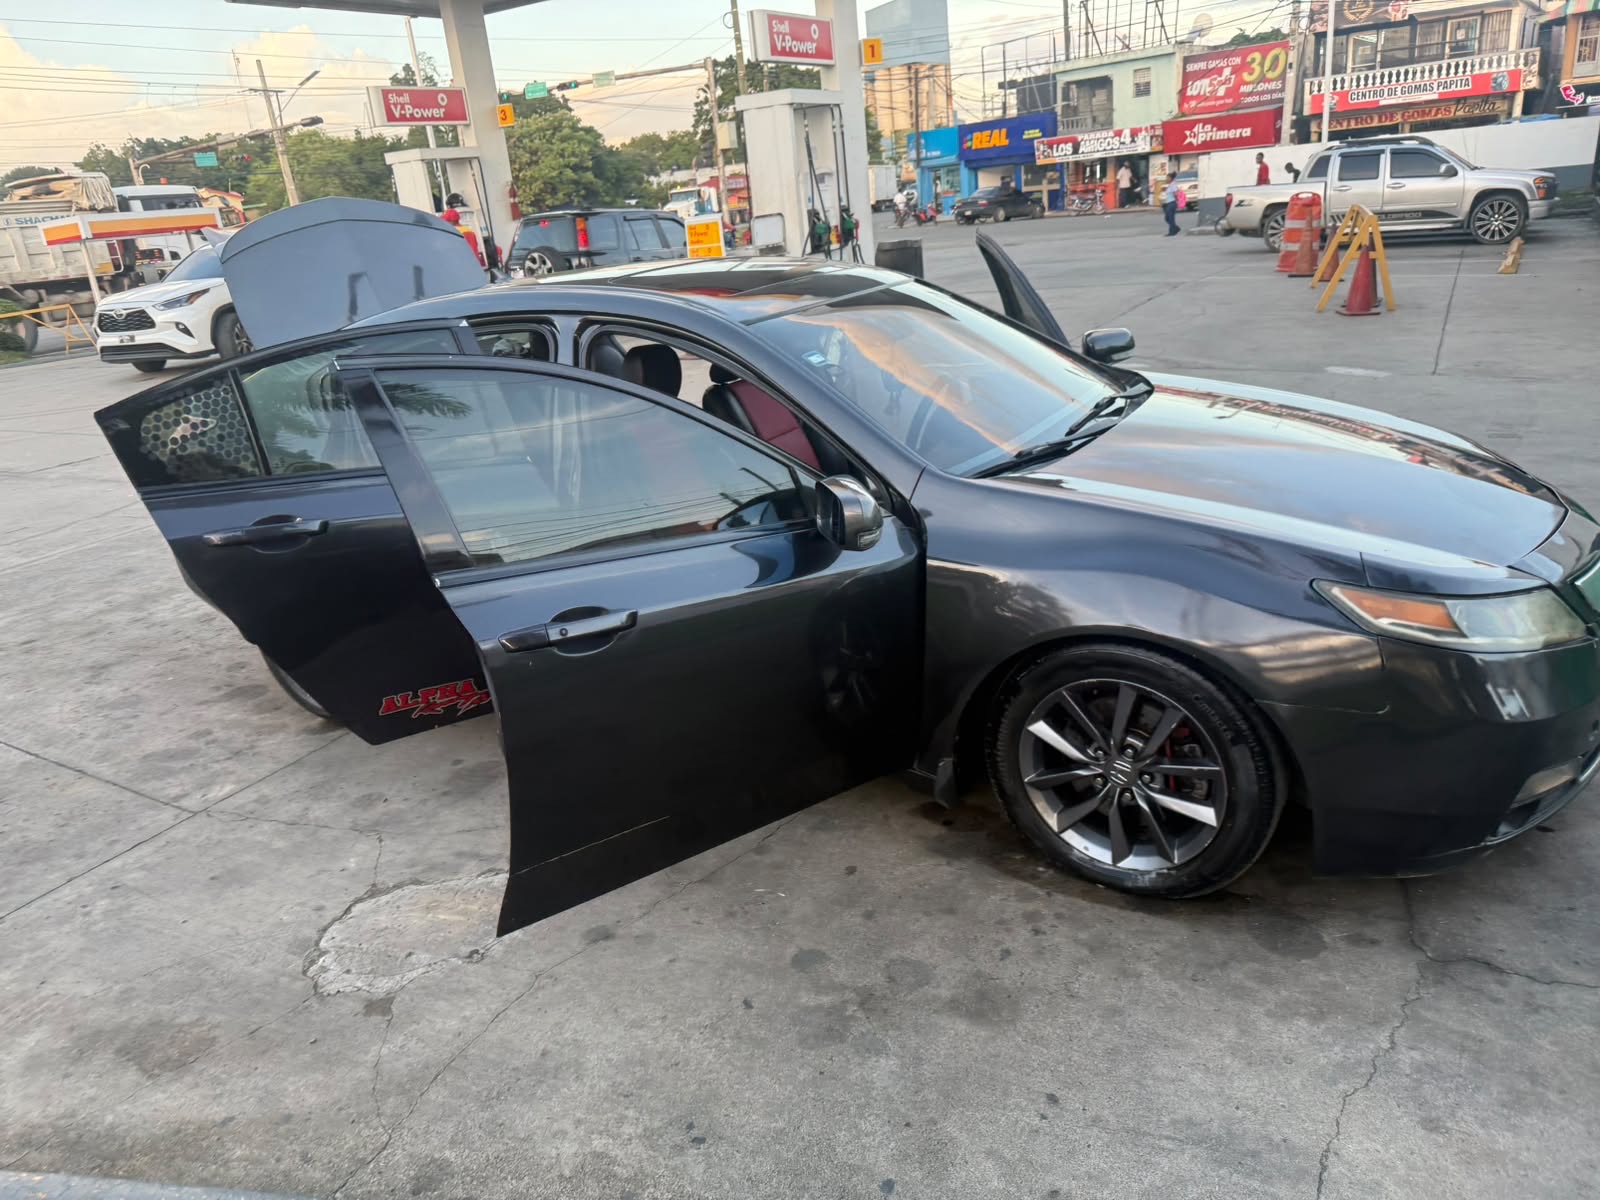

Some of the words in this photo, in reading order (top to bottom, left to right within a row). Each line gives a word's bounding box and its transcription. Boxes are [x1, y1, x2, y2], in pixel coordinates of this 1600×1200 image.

[772, 20, 790, 33] Shell
[773, 34, 817, 54] V-Power
[868, 43, 876, 58] 1
[1185, 60, 1207, 72] SIEMPRE
[1228, 56, 1241, 66] CON
[1241, 47, 1288, 82] 30
[1350, 88, 1385, 102] CENTRO
[1387, 86, 1399, 97] DE
[1401, 82, 1435, 96] GOMAS
[1436, 77, 1471, 92] PAPITA
[388, 93, 410, 104] Shell
[1260, 94, 1271, 102] LOS
[390, 104, 446, 119] V-Power
[500, 109, 508, 121] 3
[1377, 111, 1399, 123] DE
[1401, 105, 1452, 121] GOMAS
[1453, 96, 1500, 117] Papita
[1199, 122, 1212, 132] La
[972, 128, 1009, 150] REAL
[1053, 142, 1073, 157] LOS
[1078, 136, 1119, 154] AMIGOS
[1120, 128, 1132, 145] 4
[1198, 127, 1251, 144] primera
[15, 213, 76, 225] SHACM
[379, 679, 477, 715] ALPHA
